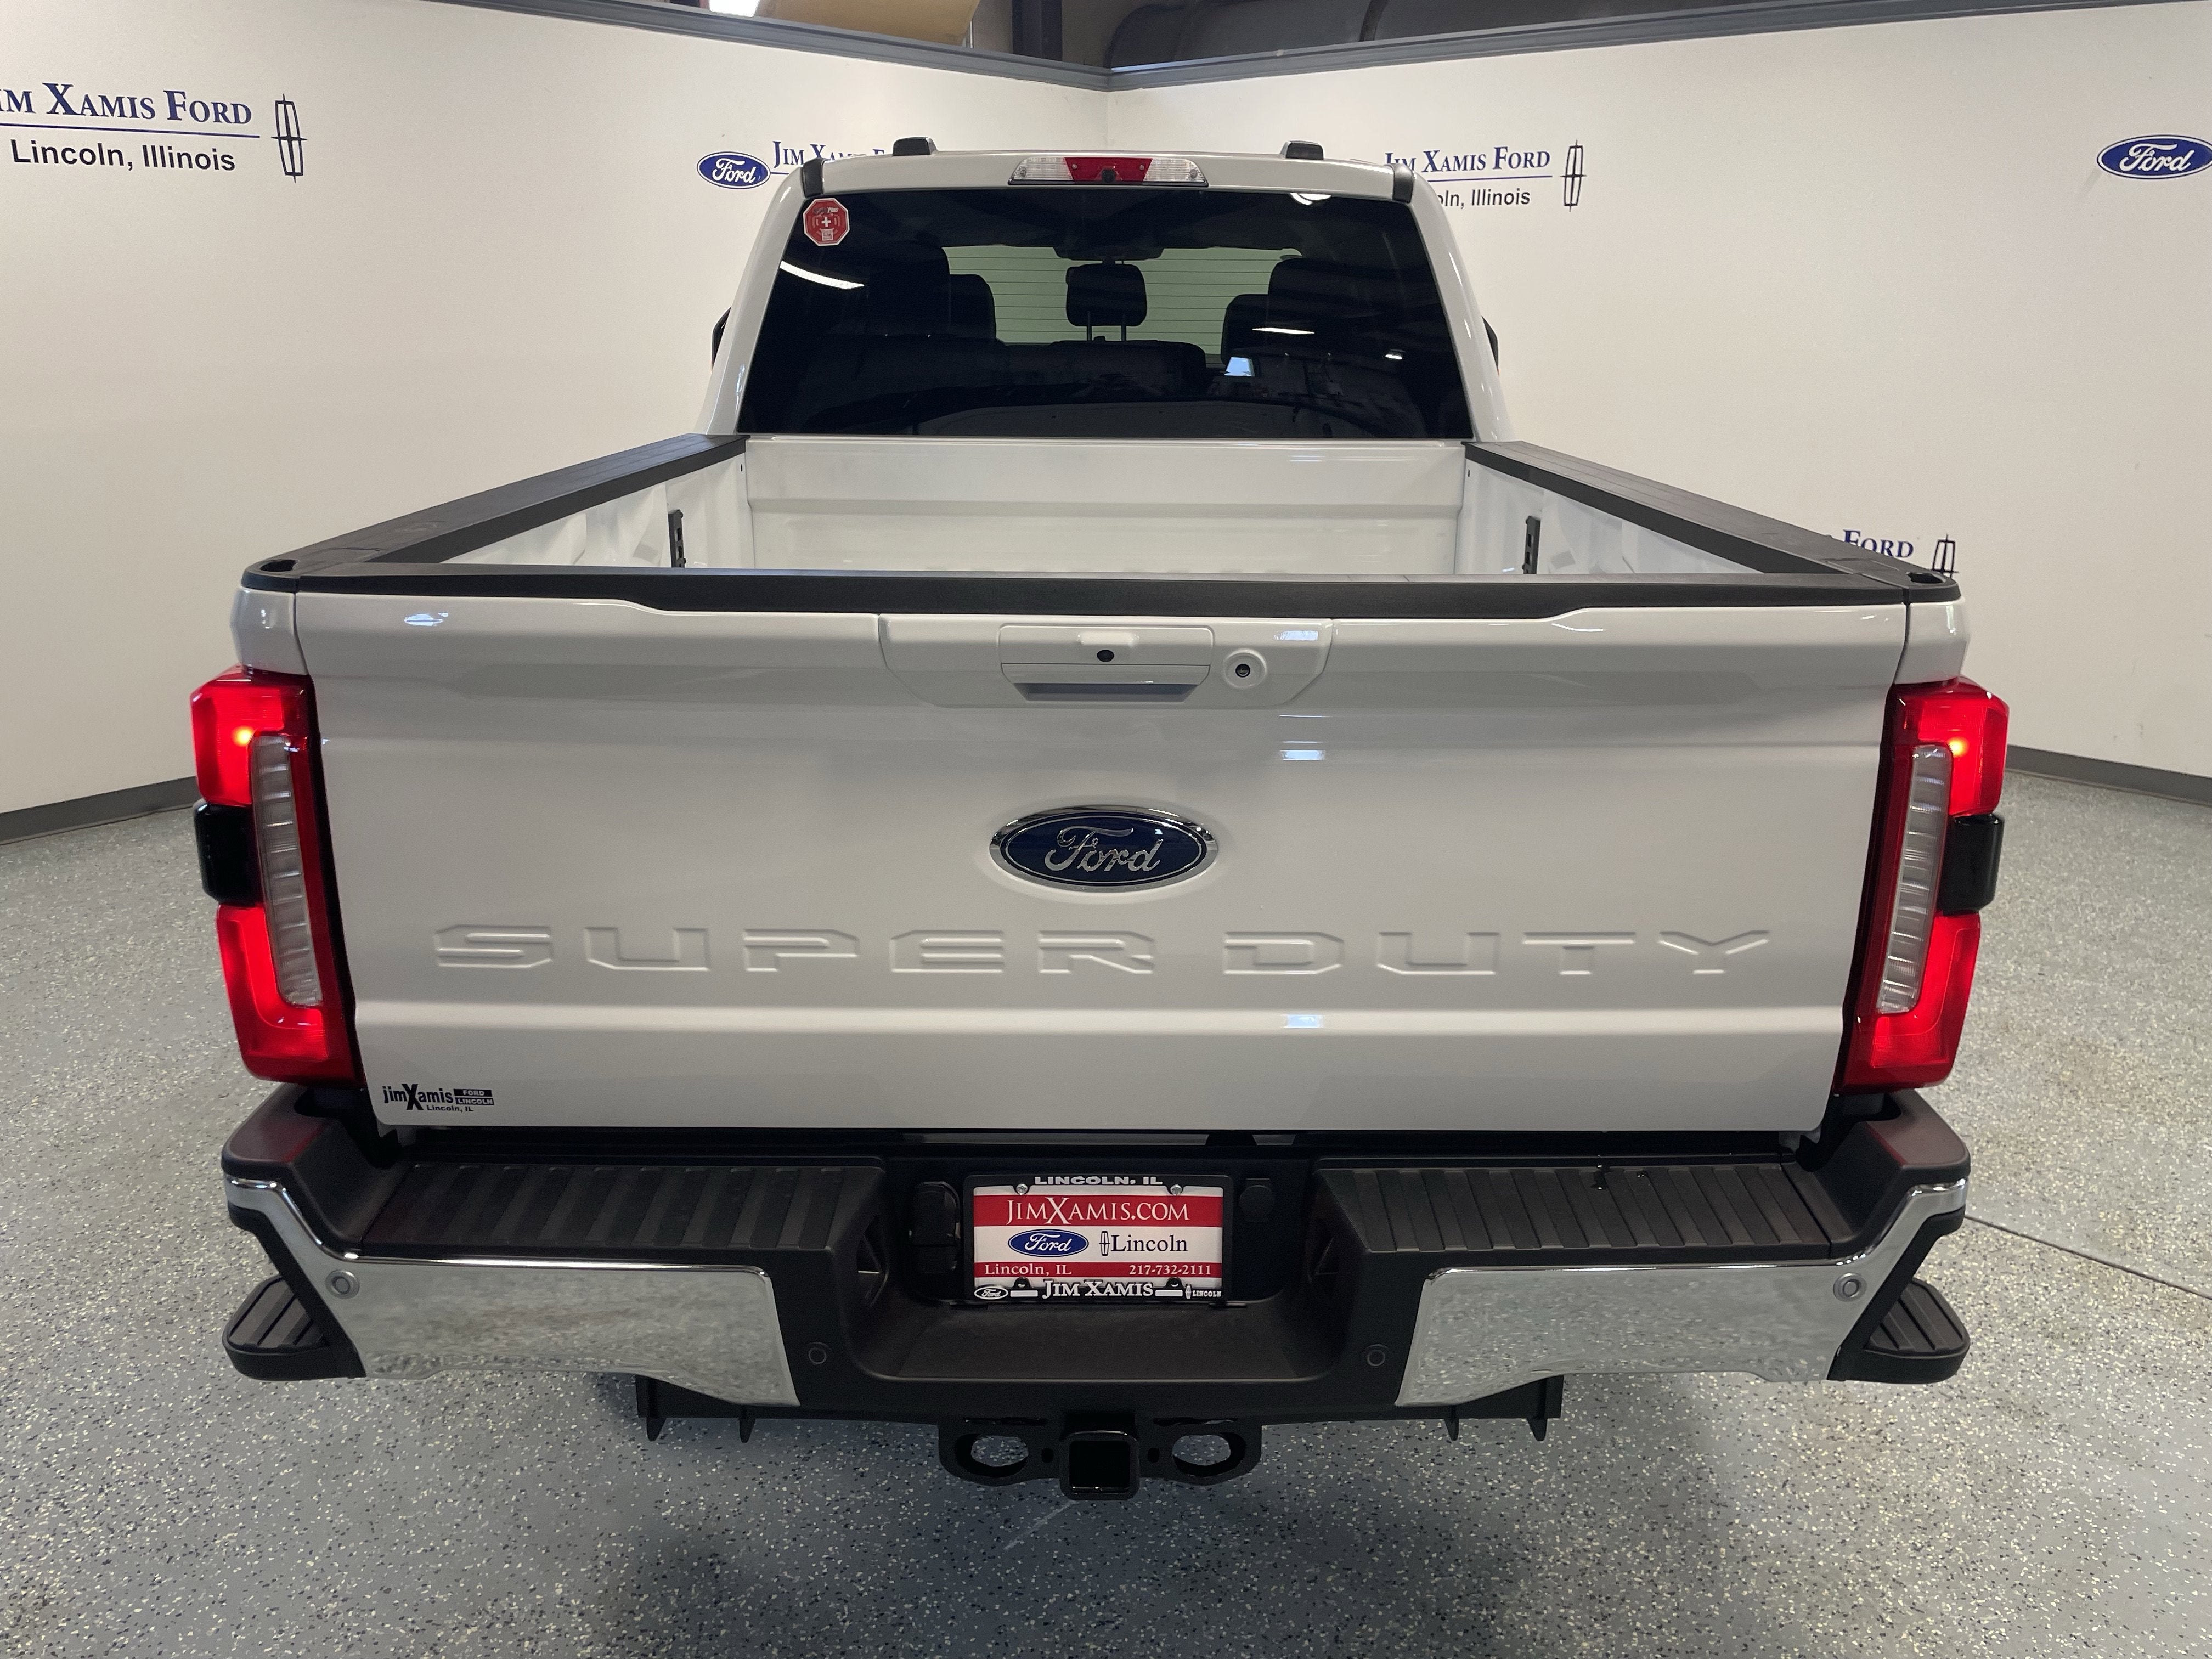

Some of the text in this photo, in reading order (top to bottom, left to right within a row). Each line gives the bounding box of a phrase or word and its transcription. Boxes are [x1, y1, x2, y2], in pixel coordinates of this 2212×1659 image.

[42, 82, 155, 119] XAMIS
[163, 90, 252, 125] FORD
[10, 139, 235, 171] Lincoln, Illinois
[772, 140, 804, 168] JIM
[1421, 150, 1486, 172] XAMIS
[1492, 146, 1551, 170] FORD
[2119, 143, 2194, 171] Ford
[712, 157, 757, 183] Ford
[1471, 188, 1531, 206] Illinois
[1045, 826, 1163, 872] Ford
[435, 924, 1770, 976] SUPER DUTY
[1035, 1176, 1163, 1185] LINCOLN, IL
[1006, 1197, 1190, 1224] JIMXAMIS.COM
[1024, 1233, 1073, 1252] Ford
[1110, 1234, 1188, 1252] Lincoln
[984, 1264, 1072, 1276] Lincoln, IL
[1129, 1265, 1211, 1275] 217-732-2111
[981, 1289, 1002, 1297] Ford
[1042, 1280, 1153, 1299] JIM XAMIS
